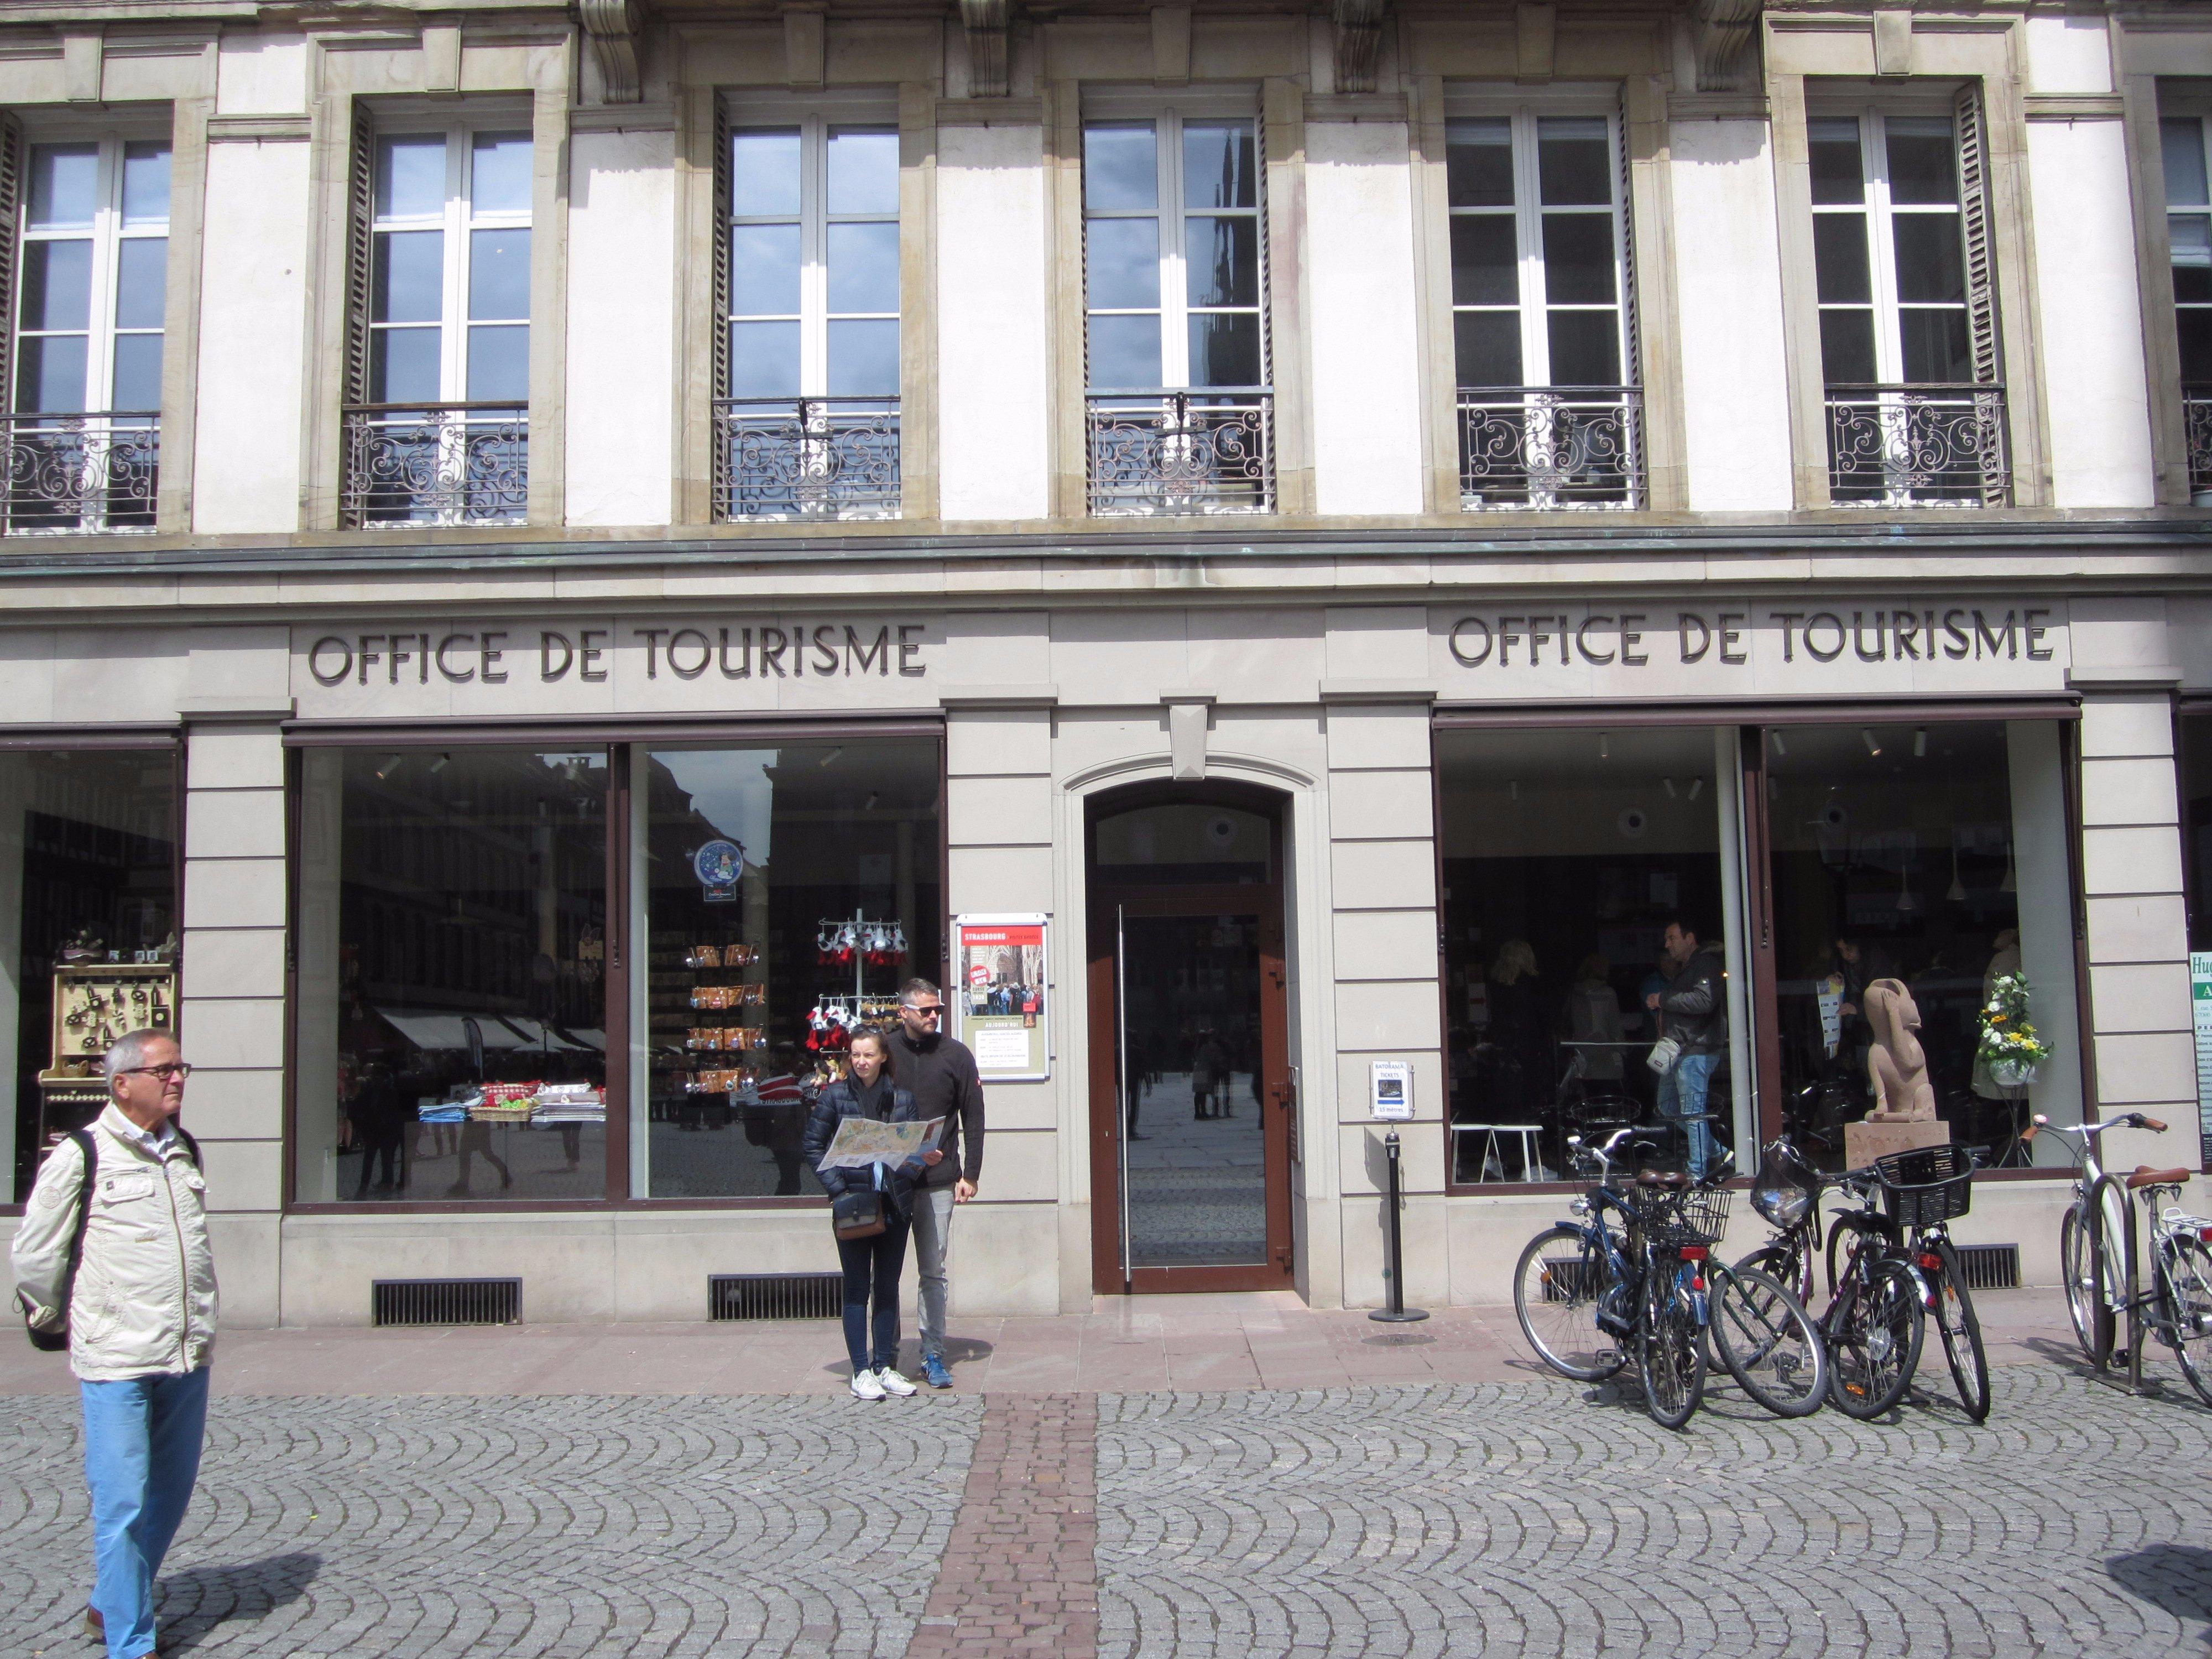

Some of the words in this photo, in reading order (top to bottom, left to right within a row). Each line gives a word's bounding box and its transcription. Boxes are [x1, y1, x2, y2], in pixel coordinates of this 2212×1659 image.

[308, 632, 508, 685] OFFICE
[540, 629, 608, 681] DE
[633, 625, 926, 679] TOURISME
[1449, 613, 1648, 666] OFFICE
[1678, 612, 1747, 664] DE
[1770, 609, 2053, 662] TOURISME
